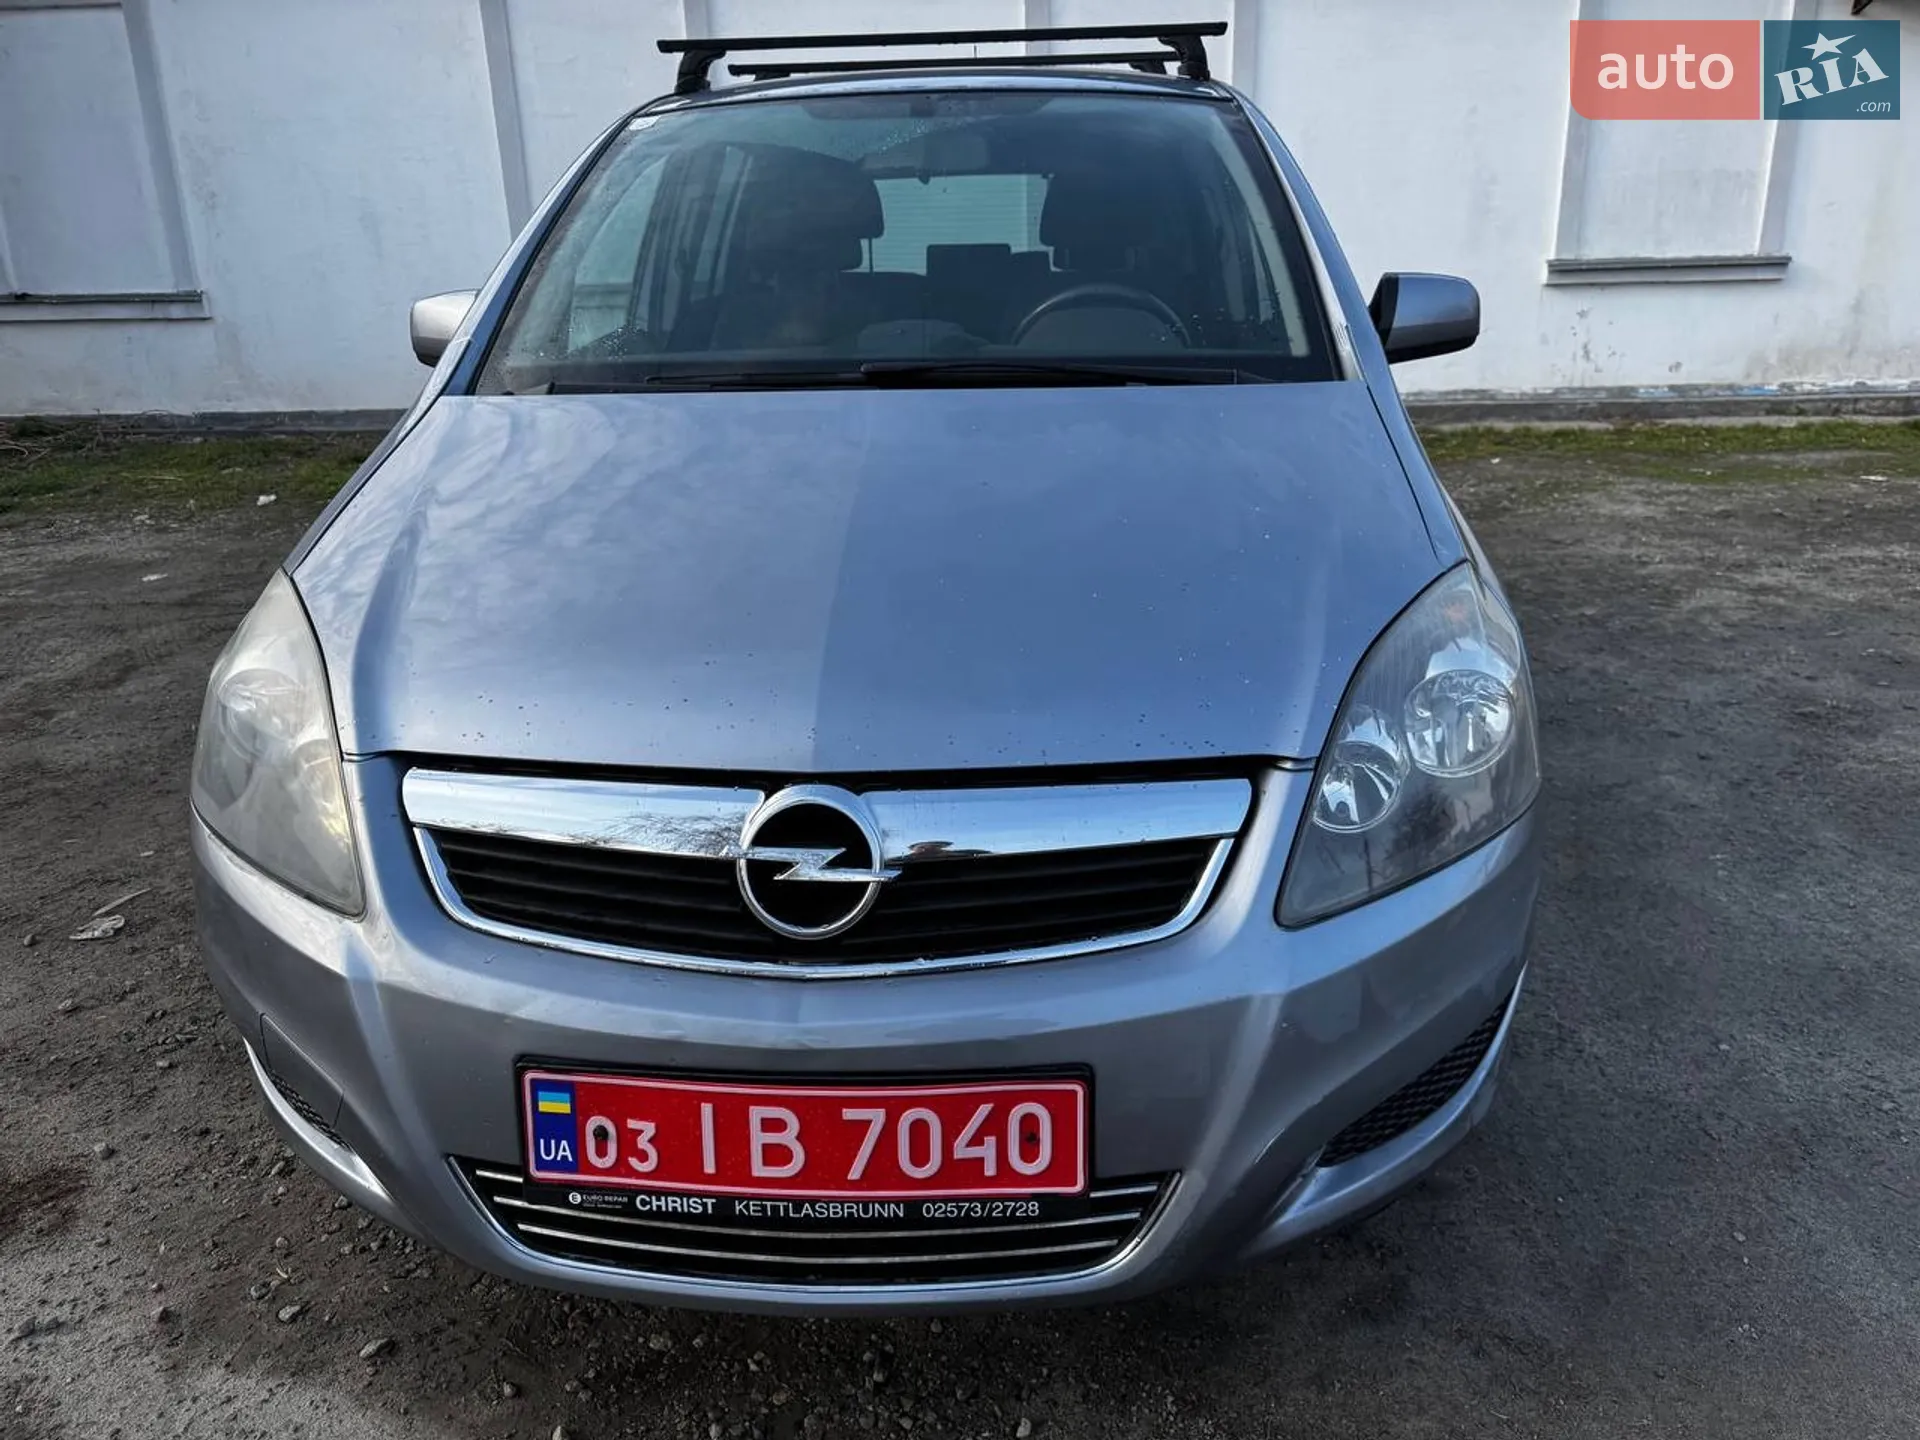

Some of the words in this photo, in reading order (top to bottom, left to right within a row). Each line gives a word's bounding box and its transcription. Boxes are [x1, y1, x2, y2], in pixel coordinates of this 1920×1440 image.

[539, 1138, 574, 1162] UA
[585, 1115, 659, 1173] 03
[841, 1102, 1053, 1181] 7040
[635, 1194, 717, 1215] CHRIST
[734, 1199, 905, 1219] KETTLASBRUNN
[921, 1201, 1041, 1218] 02573/2728
